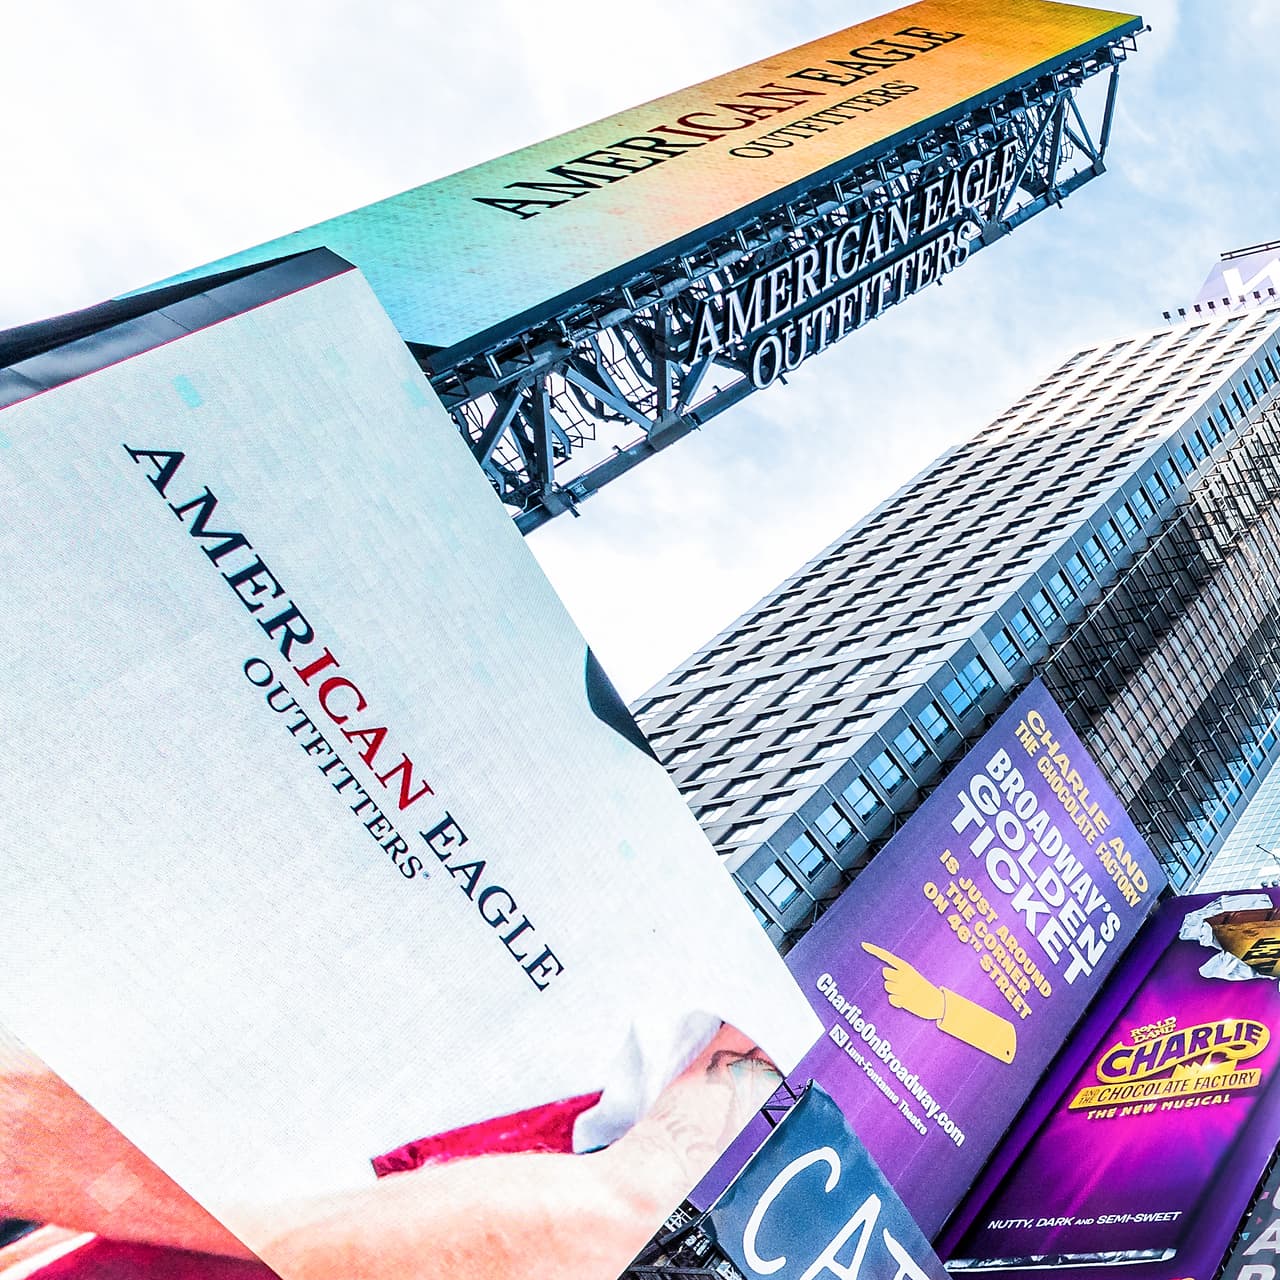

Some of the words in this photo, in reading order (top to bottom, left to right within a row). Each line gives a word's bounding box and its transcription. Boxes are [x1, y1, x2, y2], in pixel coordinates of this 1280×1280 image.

[473, 82, 826, 220] AMERICAN
[786, 26, 967, 86] EAGLE
[728, 80, 920, 159] OUTFITTERS
[690, 197, 913, 366] AMERICAN
[921, 140, 1020, 233] EAGLE
[750, 221, 972, 390] OUTFITTERS
[123, 444, 434, 811] AMERICAN
[420, 811, 565, 992] EAGLE
[243, 657, 424, 879] OUTFITTERS
[1027, 710, 1110, 834] CHARLIE
[1109, 837, 1148, 894] AND
[939, 849, 959, 875] IS
[958, 877, 998, 924] JUST
[996, 925, 1051, 998] AROUND
[945, 882, 975, 922] THE
[974, 921, 1030, 995] CORNER
[951, 791, 1092, 984] TICKET
[970, 774, 1107, 967] GOLDEN
[1087, 1107, 1118, 1120] THE
[1120, 1102, 1157, 1117] NEW
[1161, 1094, 1230, 1111] MUSICAL
[1097, 1079, 1189, 1102] CHOCOLATE
[1193, 1071, 1256, 1090] FACTORY
[1101, 1022, 1264, 1078] CHARLIE
[987, 1218, 1034, 1229] NUTTY,
[1035, 1216, 1075, 1227] DARK
[1096, 1211, 1182, 1225] SEMI-SWEET
